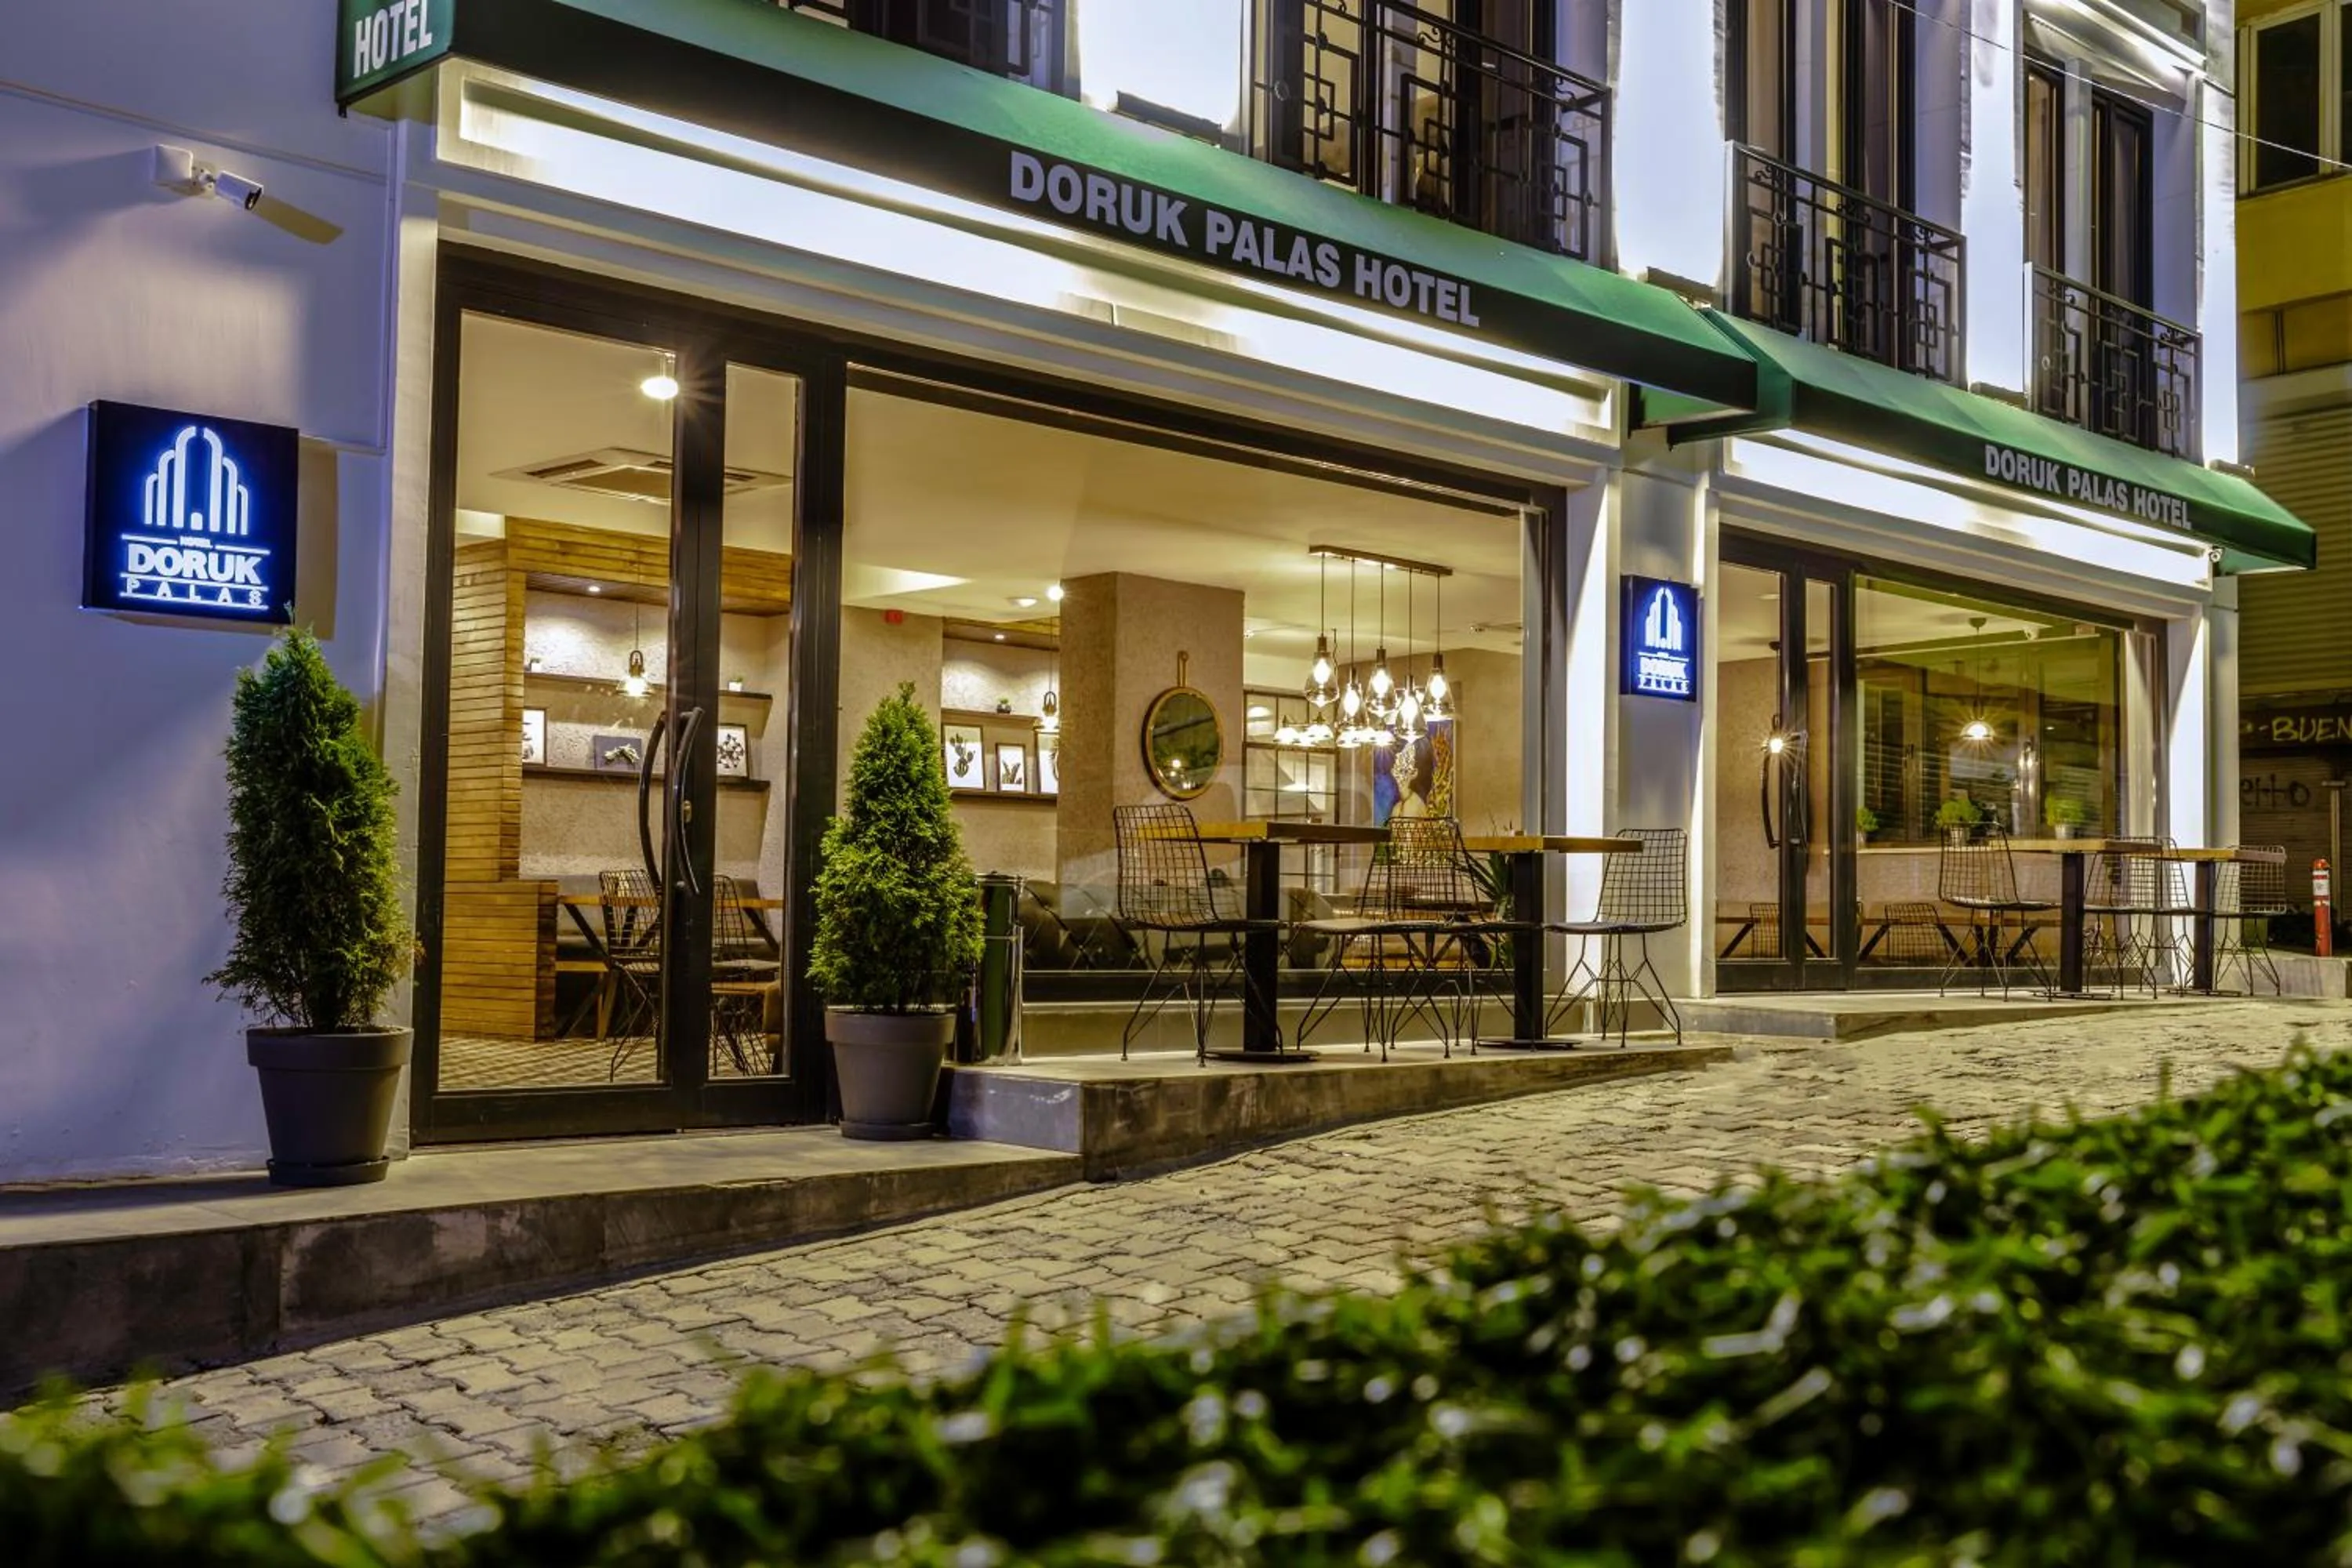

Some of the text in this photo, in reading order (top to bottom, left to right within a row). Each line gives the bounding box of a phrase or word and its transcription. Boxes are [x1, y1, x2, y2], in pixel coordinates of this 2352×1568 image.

[354, 0, 433, 78] HOTEL
[1011, 151, 1479, 327] DORUK PALAS HOTEL
[1984, 444, 2192, 531] DORUK PALAS HOTEL
[126, 577, 262, 607] PALAS
[128, 543, 262, 584] DORUK
